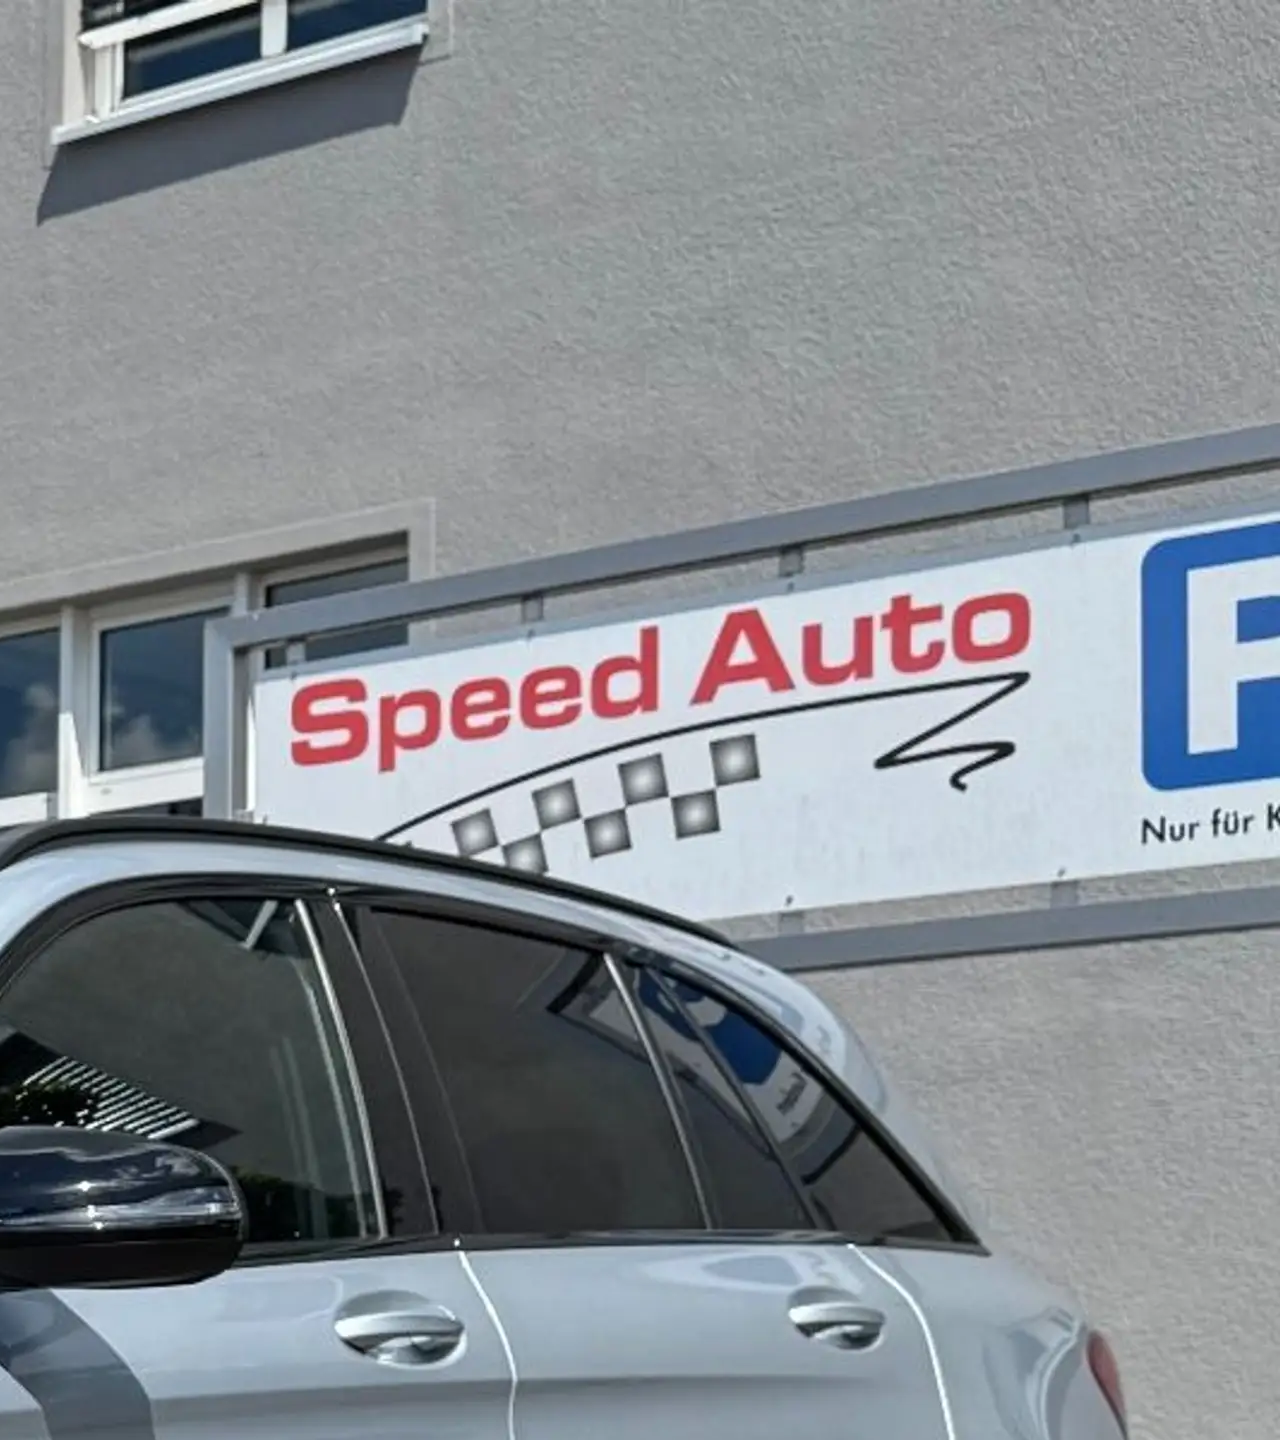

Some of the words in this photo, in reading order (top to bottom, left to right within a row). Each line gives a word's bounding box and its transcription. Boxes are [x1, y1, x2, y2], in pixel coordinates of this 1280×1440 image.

[291, 625, 658, 773] Speed
[690, 592, 1030, 705] Auto
[1141, 815, 1200, 845] Nur
[1211, 807, 1255, 838] für
